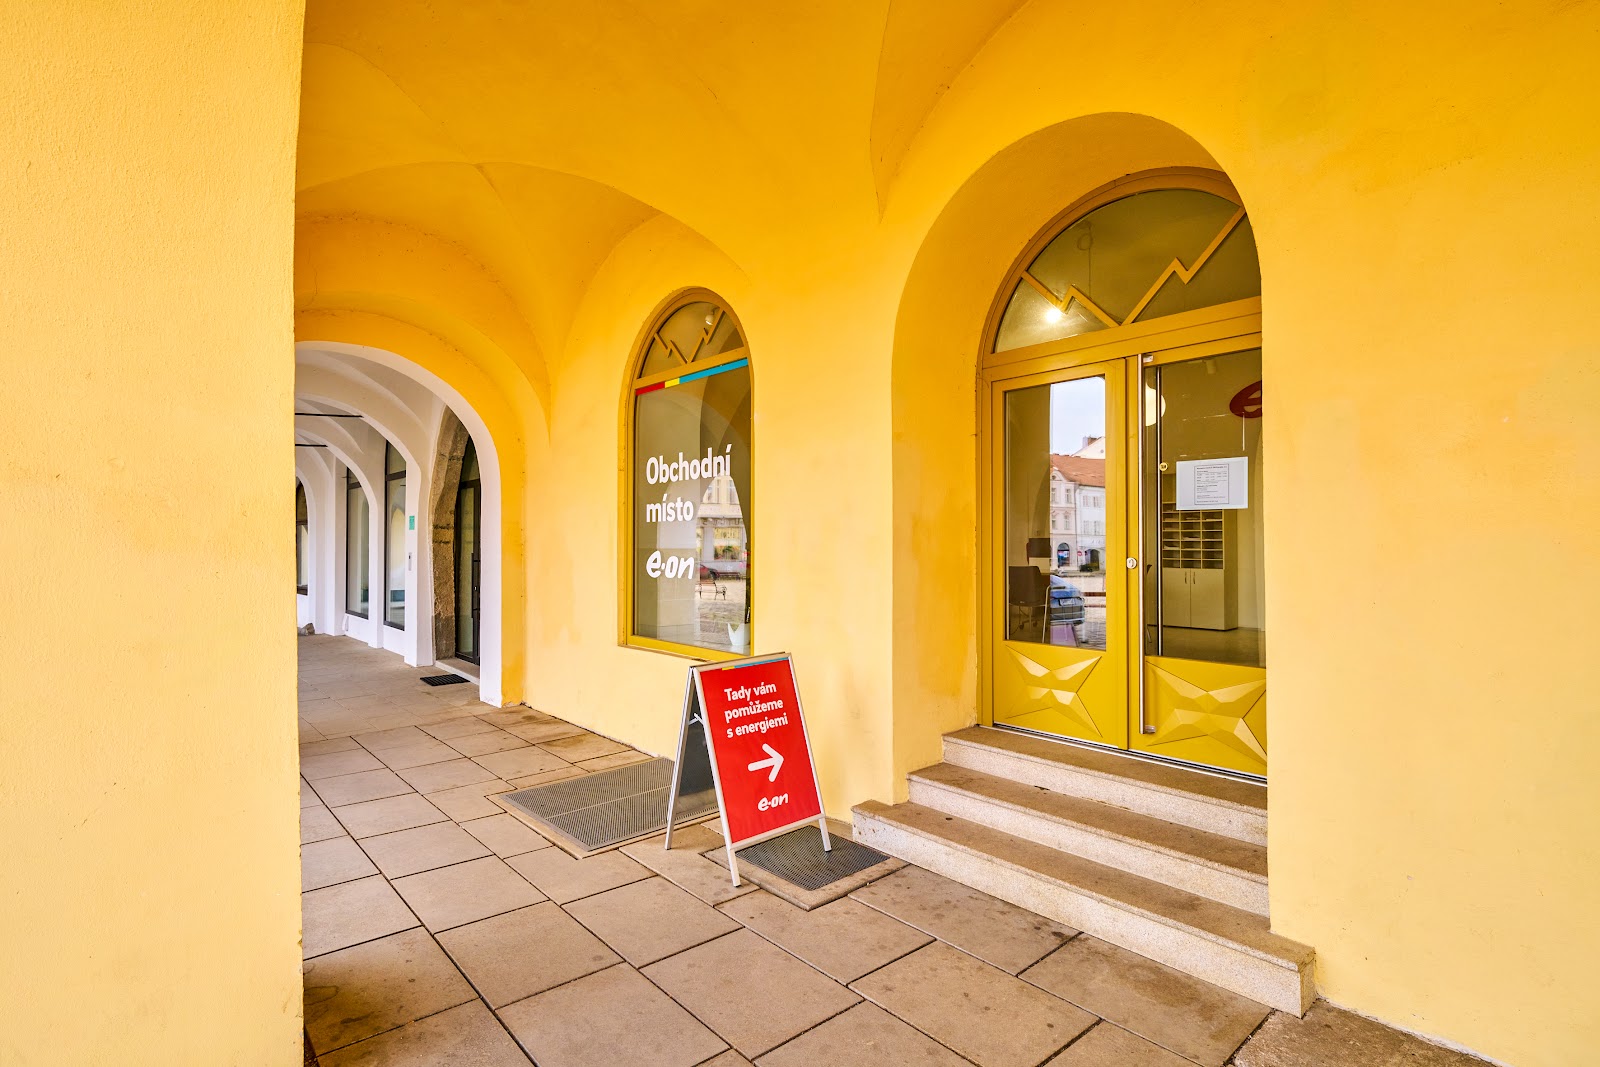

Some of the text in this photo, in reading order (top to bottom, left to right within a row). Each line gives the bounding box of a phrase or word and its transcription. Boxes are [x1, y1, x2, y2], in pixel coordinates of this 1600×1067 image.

[646, 443, 732, 485] Obchodní
[646, 493, 694, 522] místo
[724, 681, 777, 702] Tady vám
[724, 698, 784, 723] pomůžeme
[726, 713, 788, 738] s energiemi
